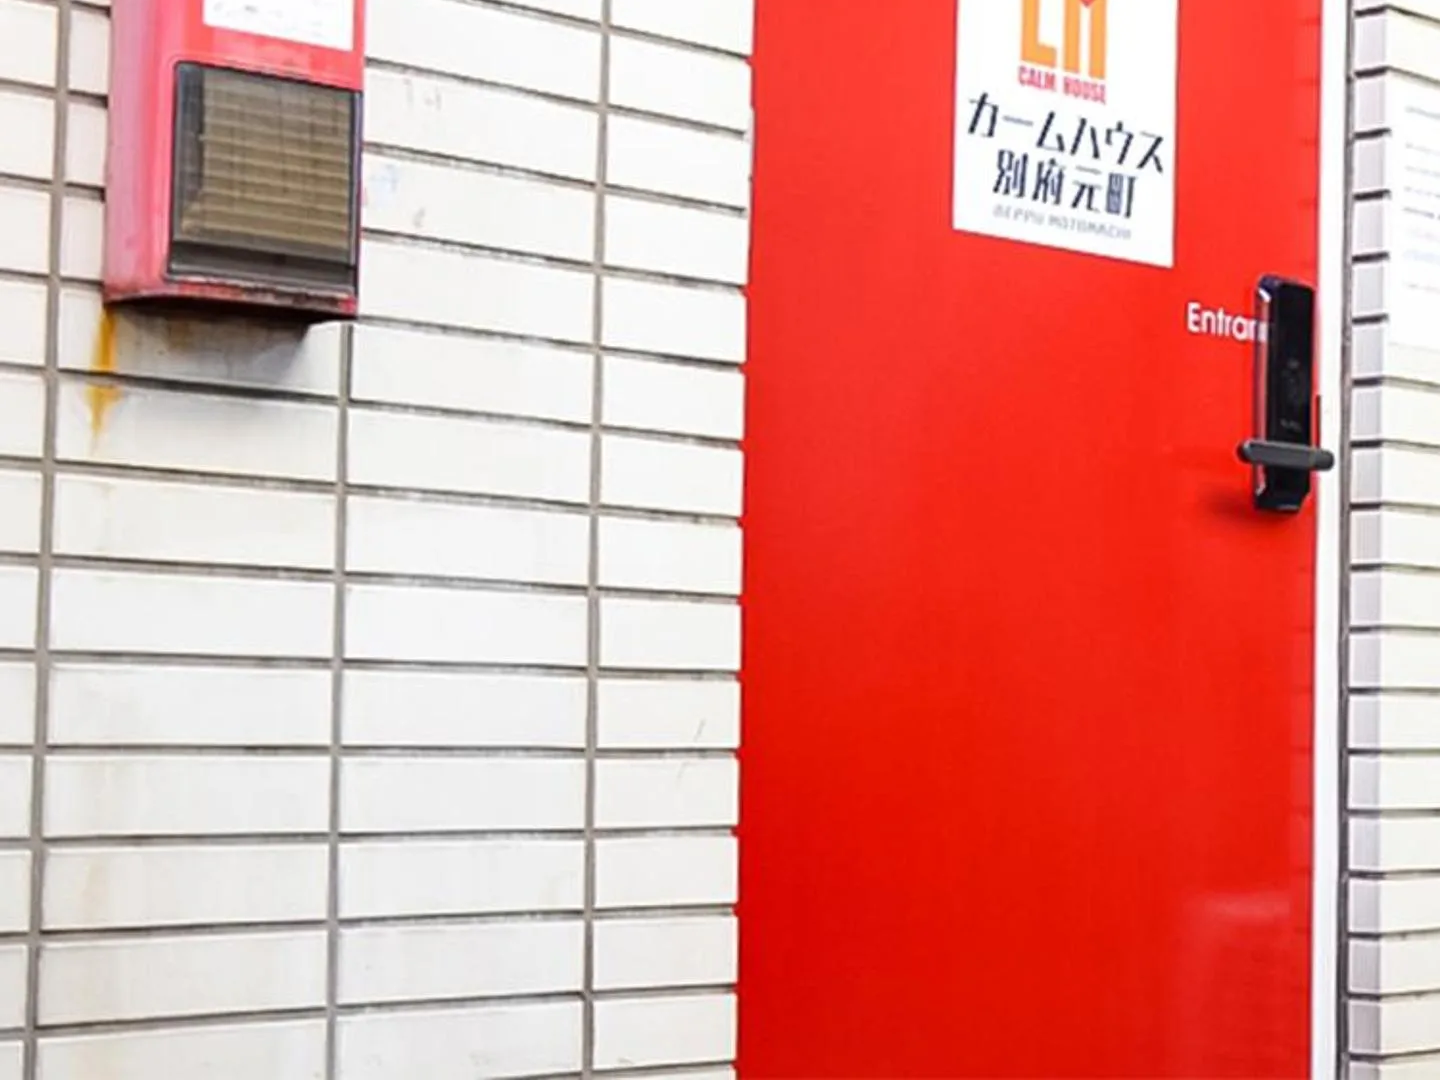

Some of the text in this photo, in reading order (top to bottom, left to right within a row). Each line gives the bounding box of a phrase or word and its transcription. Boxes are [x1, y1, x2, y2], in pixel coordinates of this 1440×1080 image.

[1018, 65, 1107, 105] CALM HOUSE
[967, 91, 1164, 174] カームハウス
[992, 149, 1137, 218] 別府元町
